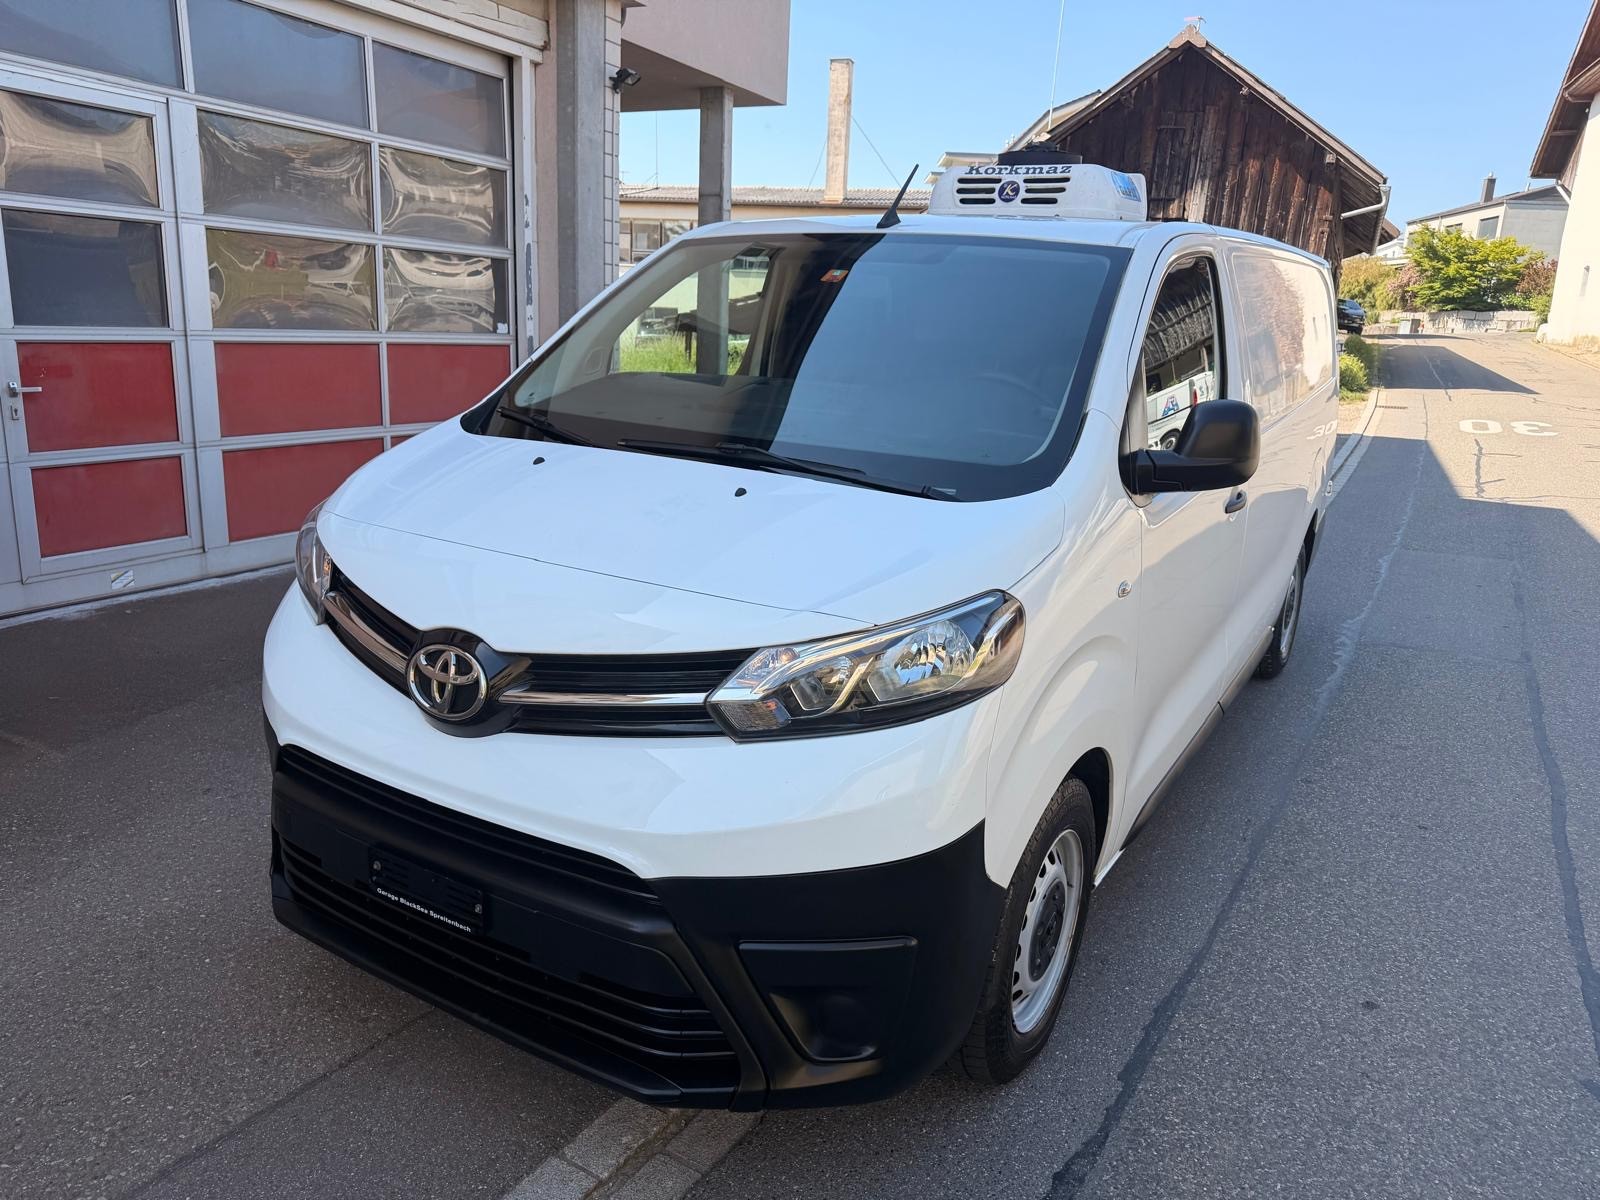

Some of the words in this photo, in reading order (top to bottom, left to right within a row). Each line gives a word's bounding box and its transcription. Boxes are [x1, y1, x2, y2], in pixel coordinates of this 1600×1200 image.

[964, 164, 1073, 175] Korkmaz
[377, 887, 398, 901] Garage
[400, 897, 429, 914] BlackSea
[429, 910, 472, 933] Spreitenbach
